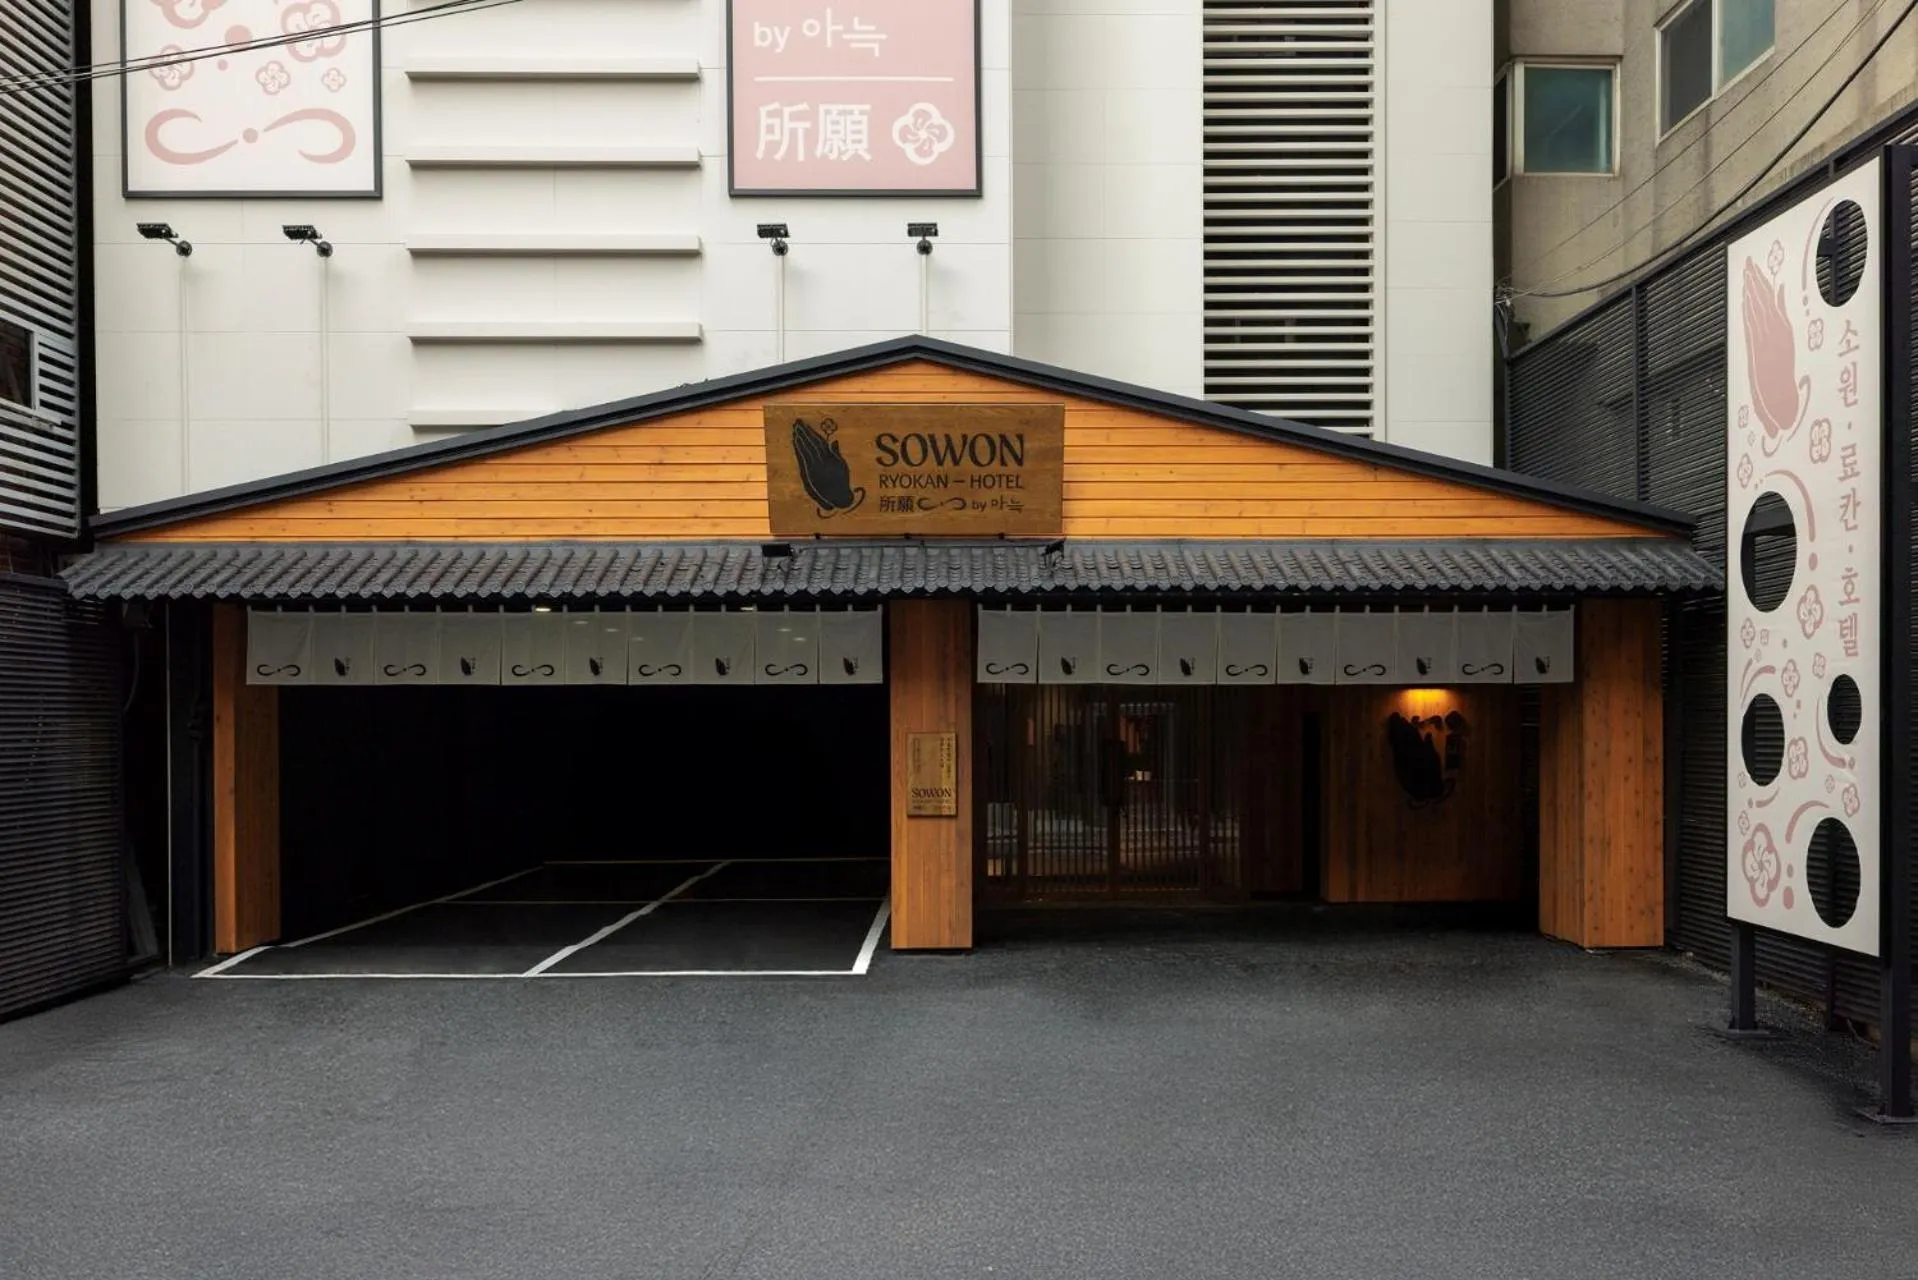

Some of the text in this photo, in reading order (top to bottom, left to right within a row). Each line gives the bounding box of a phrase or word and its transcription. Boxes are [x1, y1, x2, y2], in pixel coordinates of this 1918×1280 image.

[753, 8, 888, 57] by 아늑
[755, 102, 873, 162] 所願
[875, 432, 1025, 468] SOWON
[879, 473, 949, 489] RYOKAN
[970, 473, 1025, 489] HOTEL
[879, 495, 1025, 513] 所願 by 아늑
[911, 787, 952, 798] SOWON
